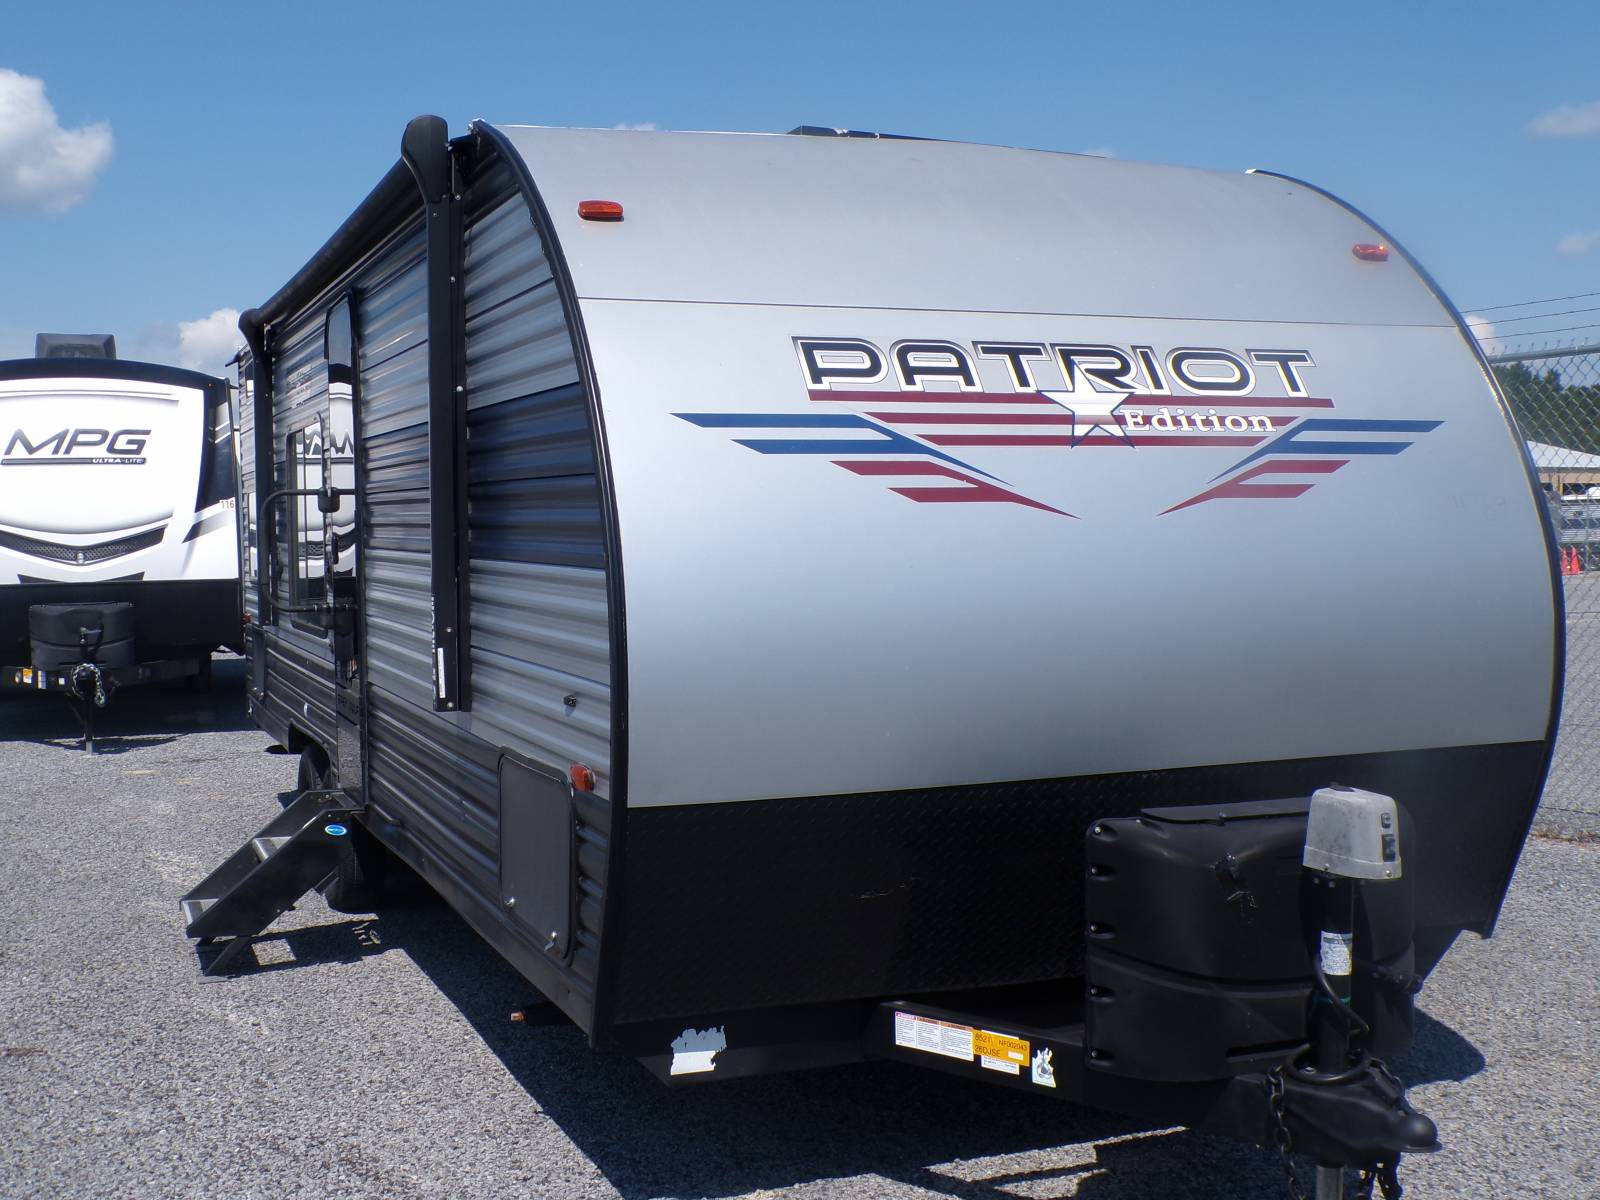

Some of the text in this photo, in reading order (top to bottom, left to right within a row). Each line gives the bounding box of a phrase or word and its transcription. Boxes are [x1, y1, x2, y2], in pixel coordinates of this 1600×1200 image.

[791, 336, 1317, 398] PATRIOT
[1119, 407, 1277, 432] Edition
[4, 428, 152, 455] MPG
